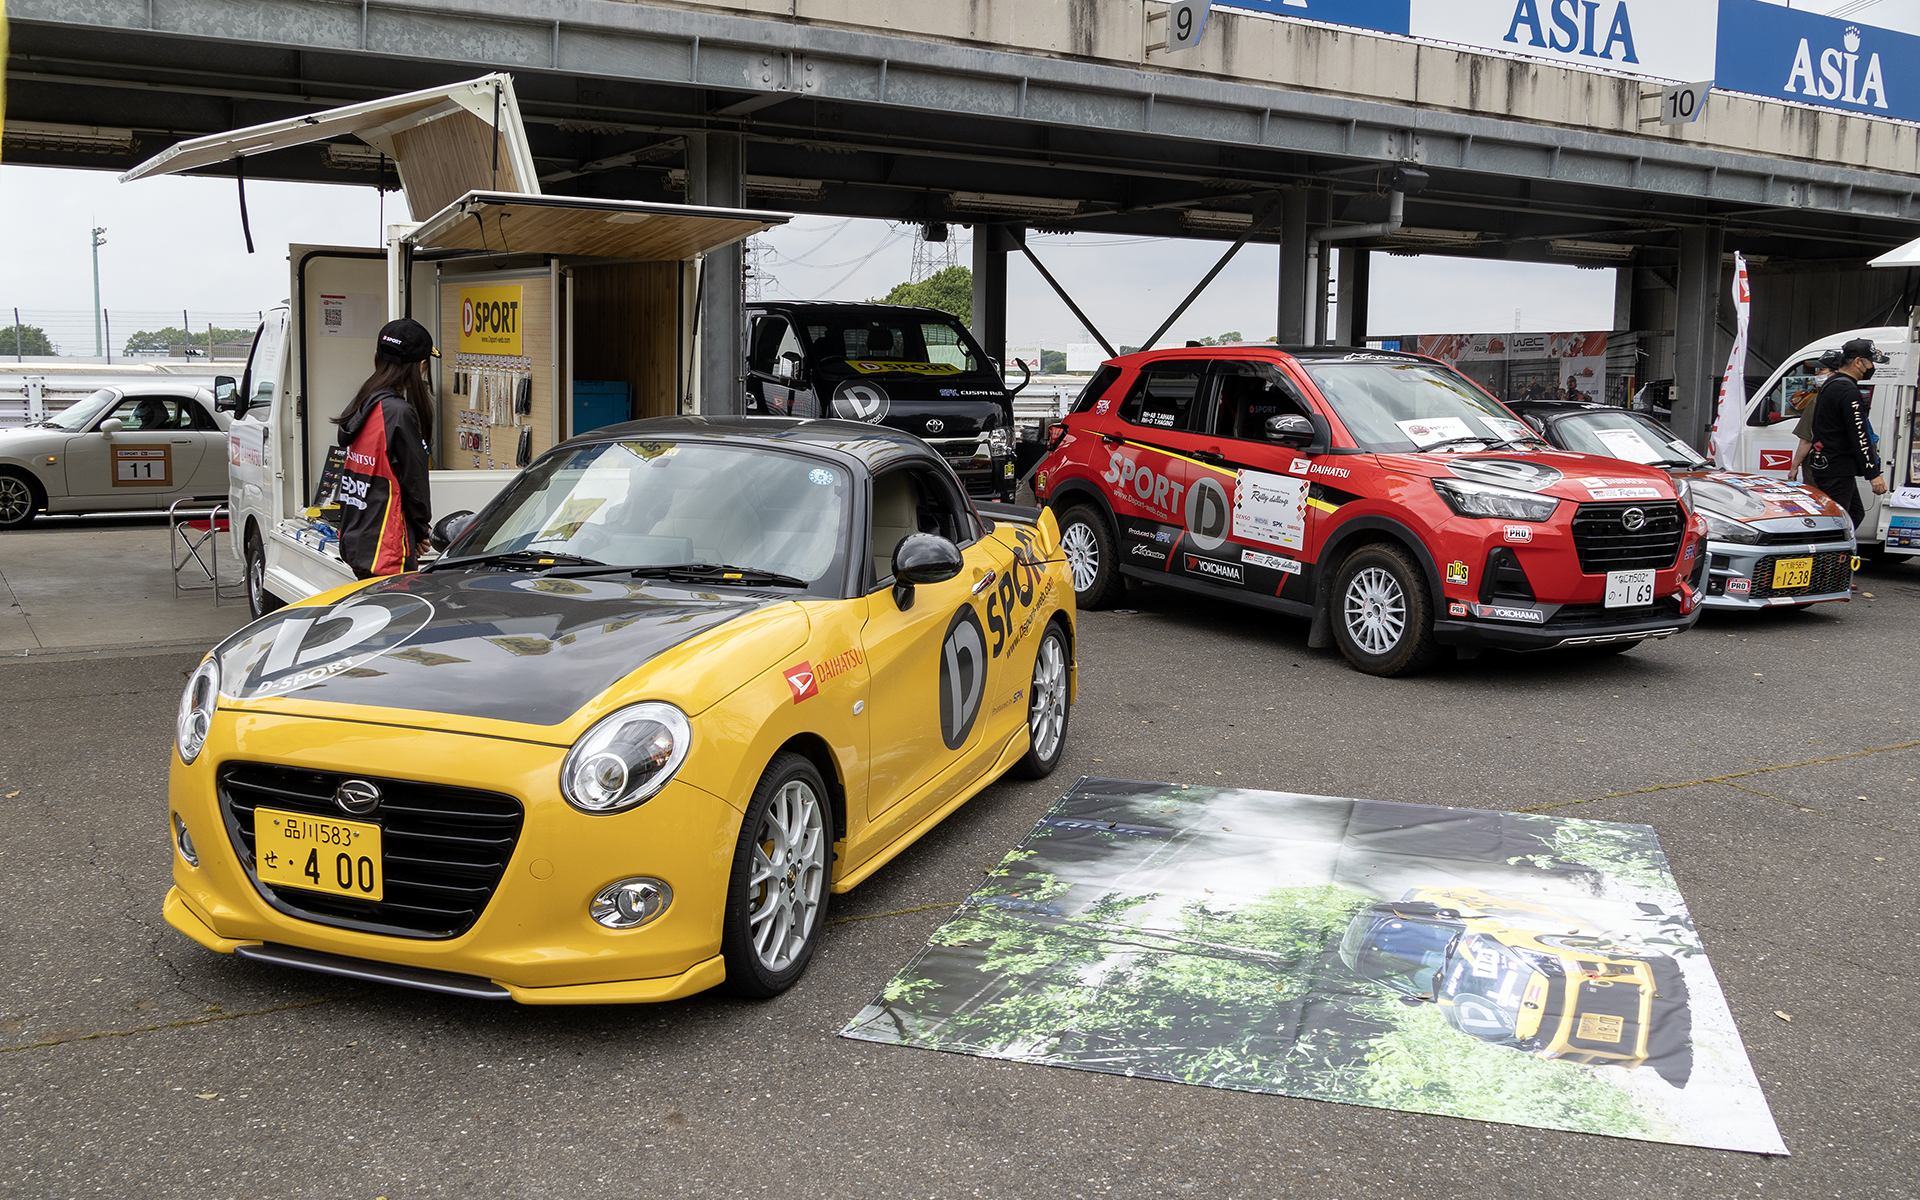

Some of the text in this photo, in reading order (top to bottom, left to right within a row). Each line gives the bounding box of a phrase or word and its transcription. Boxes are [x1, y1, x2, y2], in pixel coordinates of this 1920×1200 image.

[1176, 6, 1193, 41] 9
[1502, 0, 1640, 65] ASIA
[1784, 37, 1889, 109] ASIA
[1668, 89, 1695, 118] 10
[475, 301, 518, 334] SPORT
[1513, 338, 1544, 347] WRC
[883, 363, 953, 372] SPORT
[1255, 405, 1276, 413] SPORT
[130, 463, 151, 478] 11
[1310, 464, 1351, 479] DAIHATSU
[1104, 452, 1185, 515] SPORT
[1235, 513, 1251, 521] DENSO
[1272, 515, 1283, 528] SPK
[1128, 527, 1149, 538] Produced
[1156, 531, 1171, 544] SPK
[1509, 529, 1527, 538] PRO
[1199, 560, 1241, 580] YOKOHAMA
[1448, 561, 1467, 580] DRS
[1783, 570, 1810, 586] 12-38
[1731, 581, 1746, 590] PRO
[1452, 605, 1463, 614] PRO
[1494, 608, 1540, 620] YOKOHAMA
[815, 646, 864, 683] DAIHATSU
[255, 656, 354, 694] D-SPORT
[264, 850, 278, 869] せ
[1477, 952, 1493, 973] 114
